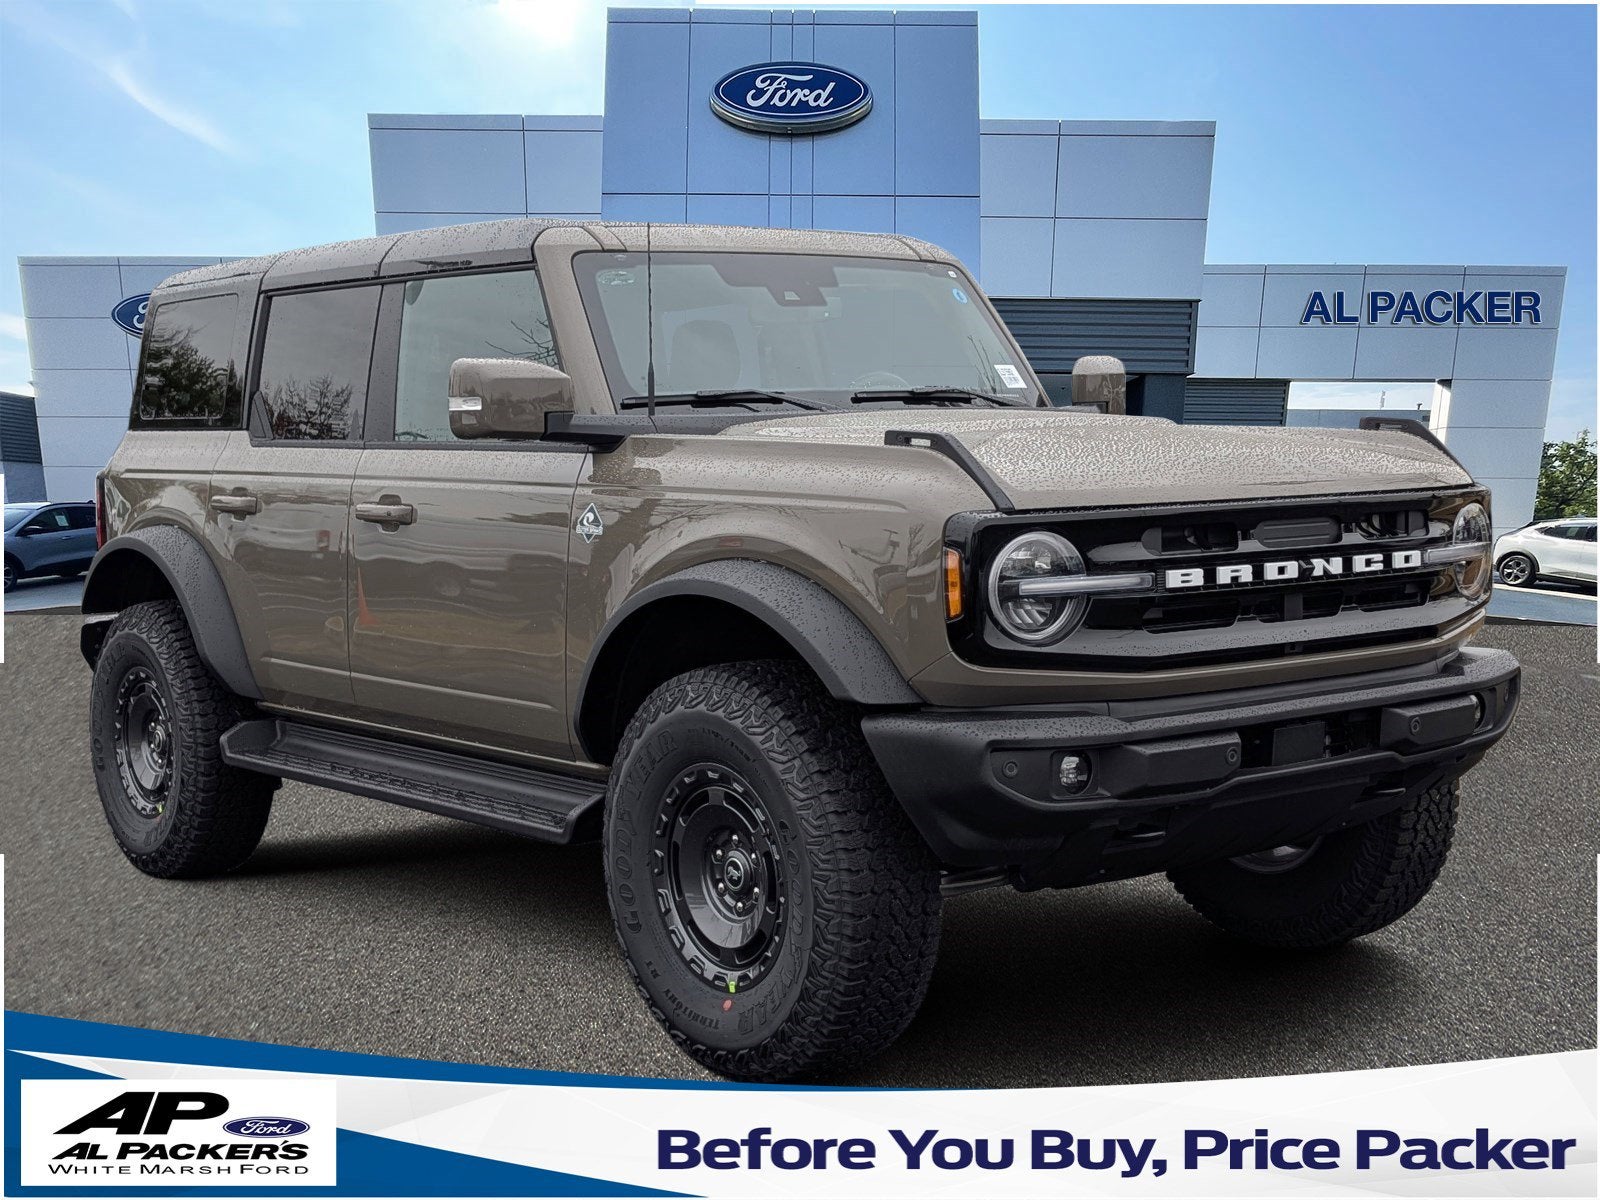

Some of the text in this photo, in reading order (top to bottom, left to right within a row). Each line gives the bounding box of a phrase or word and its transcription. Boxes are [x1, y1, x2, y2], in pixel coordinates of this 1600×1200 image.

[746, 73, 836, 107] Ford
[1301, 289, 1542, 325] AL PACKER
[1165, 550, 1422, 588] BRONCO
